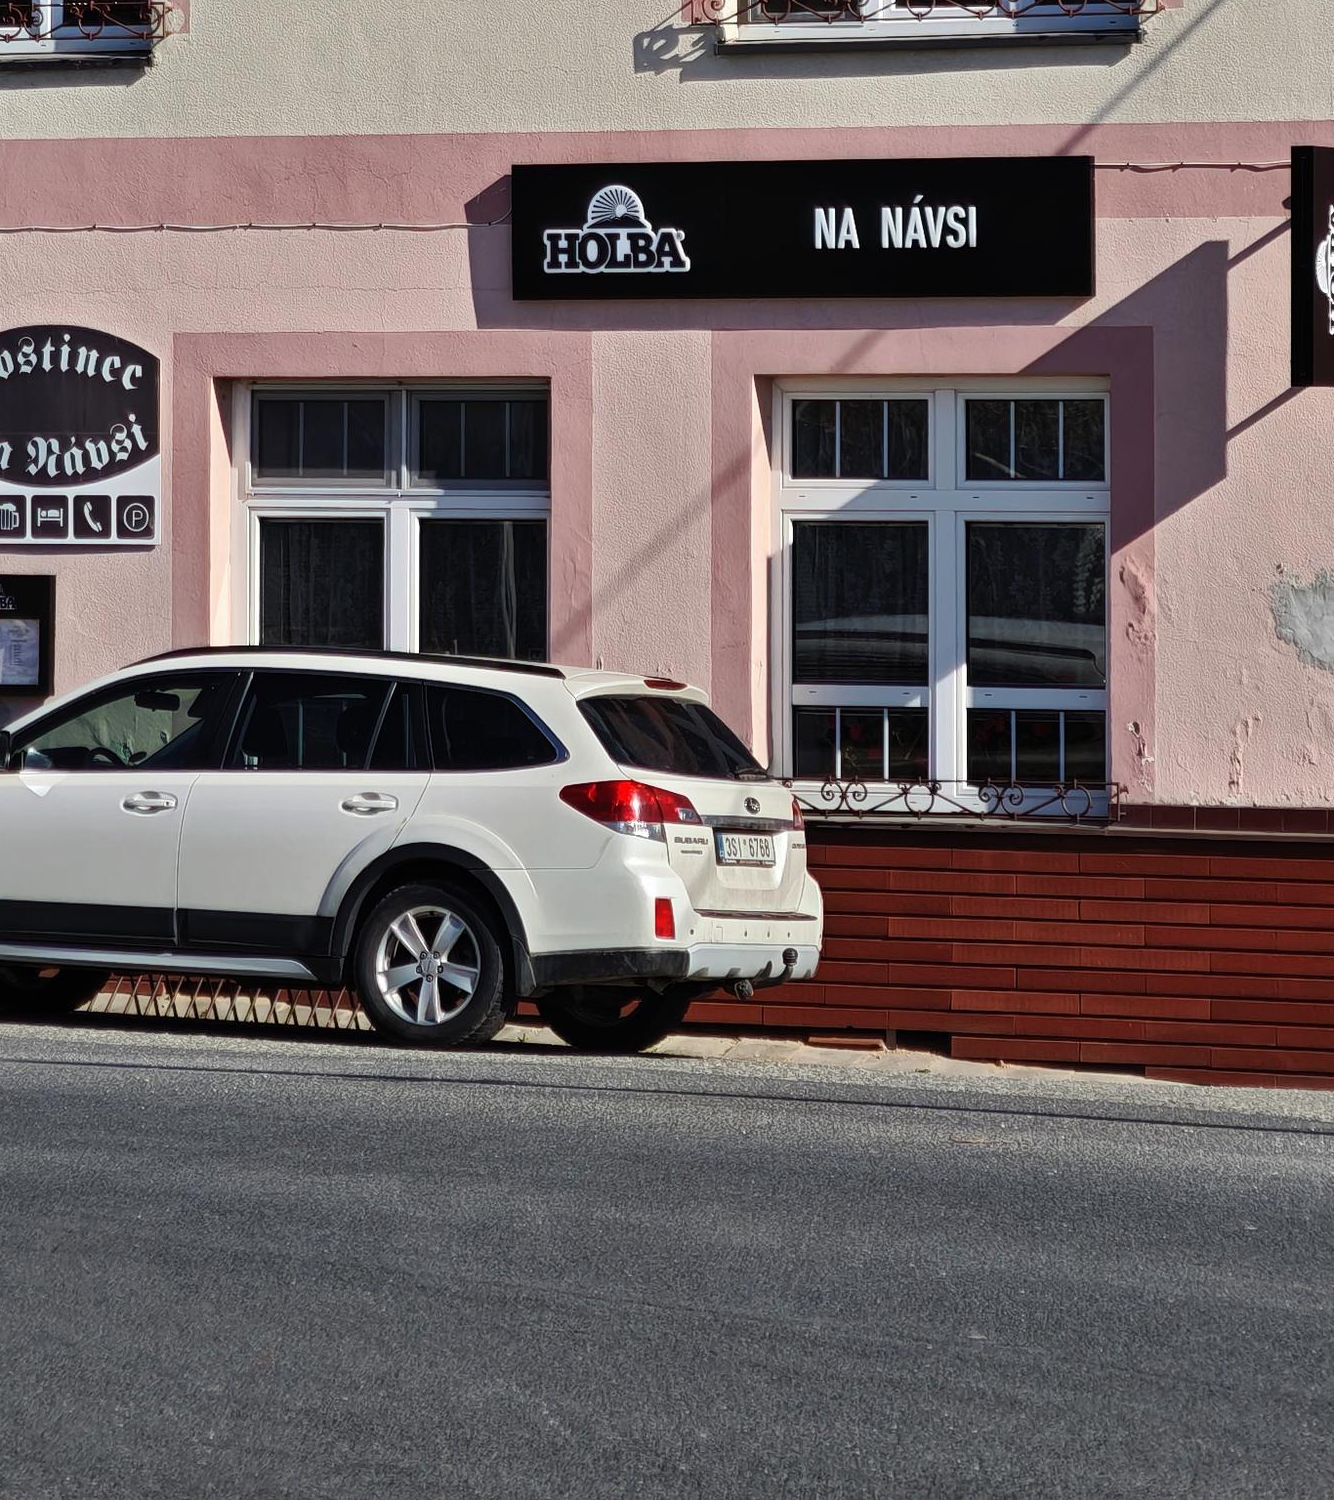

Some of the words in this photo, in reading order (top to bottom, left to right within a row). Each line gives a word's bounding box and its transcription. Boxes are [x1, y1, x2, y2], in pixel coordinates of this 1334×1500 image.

[814, 206, 860, 249] NA
[881, 195, 977, 249] NÁVSI
[544, 229, 689, 272] HOLBA
[25, 413, 149, 478] Návsi
[674, 836, 709, 846] SUBARU
